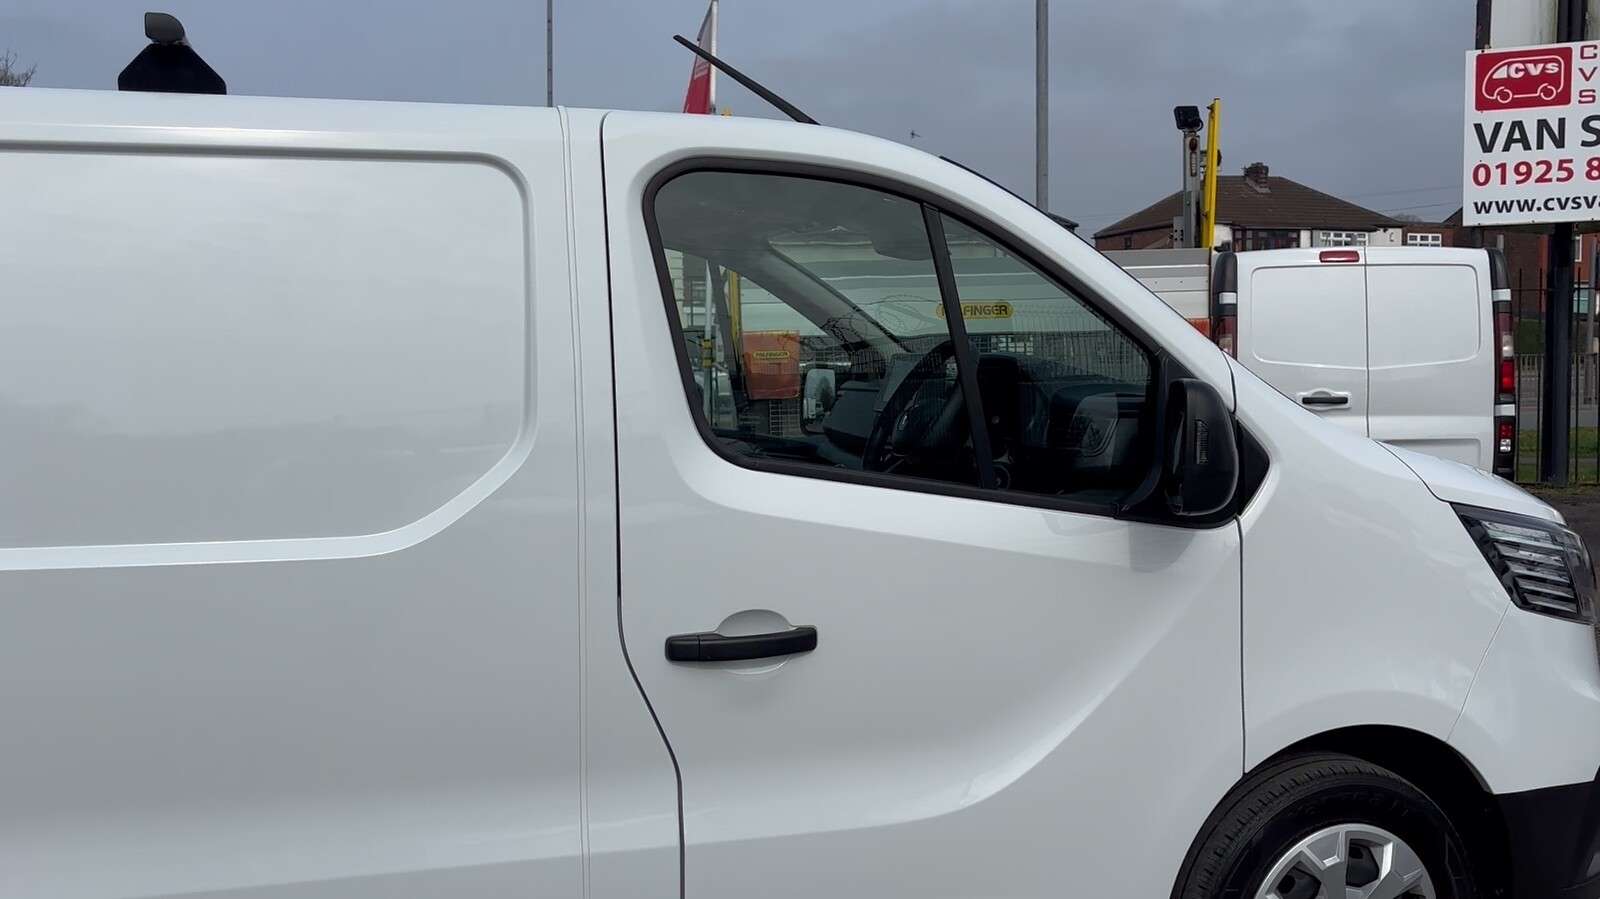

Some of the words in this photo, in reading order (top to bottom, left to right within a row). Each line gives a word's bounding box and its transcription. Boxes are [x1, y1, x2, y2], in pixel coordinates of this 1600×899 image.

[1508, 62, 1560, 79] CVS
[1473, 117, 1566, 153] VAN
[1472, 158, 1574, 187] 01925
[1473, 195, 1600, 214] www.cvsv
[941, 304, 1008, 316] FINGER
